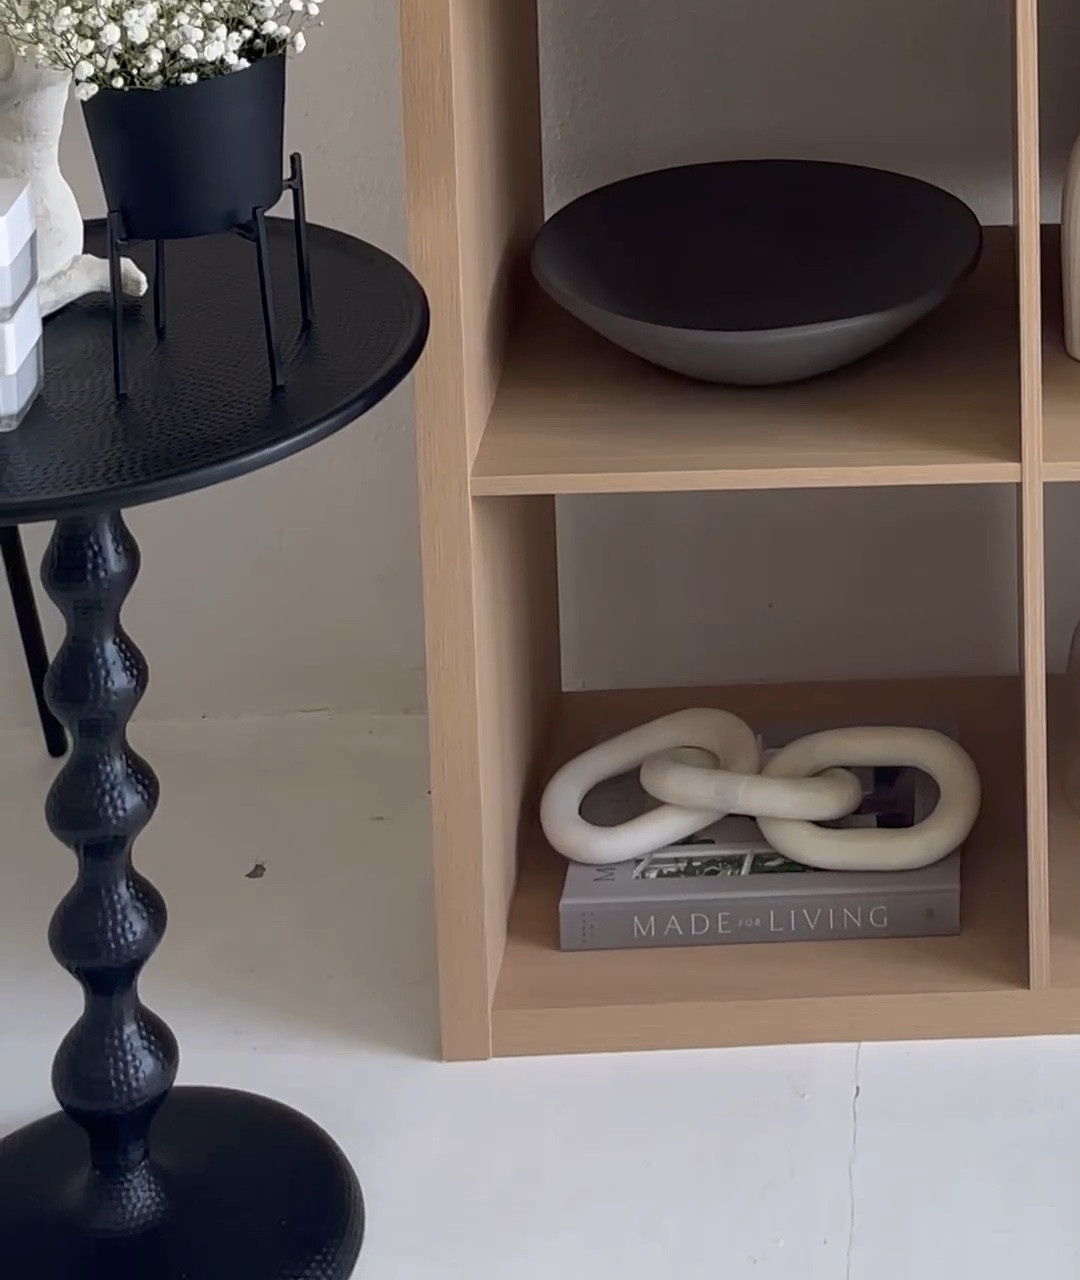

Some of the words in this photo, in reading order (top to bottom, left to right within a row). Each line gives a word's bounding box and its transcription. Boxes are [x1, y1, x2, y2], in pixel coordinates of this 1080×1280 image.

[633, 911, 732, 938] MADE
[738, 917, 761, 928] FOR
[769, 905, 888, 933] LIVING
